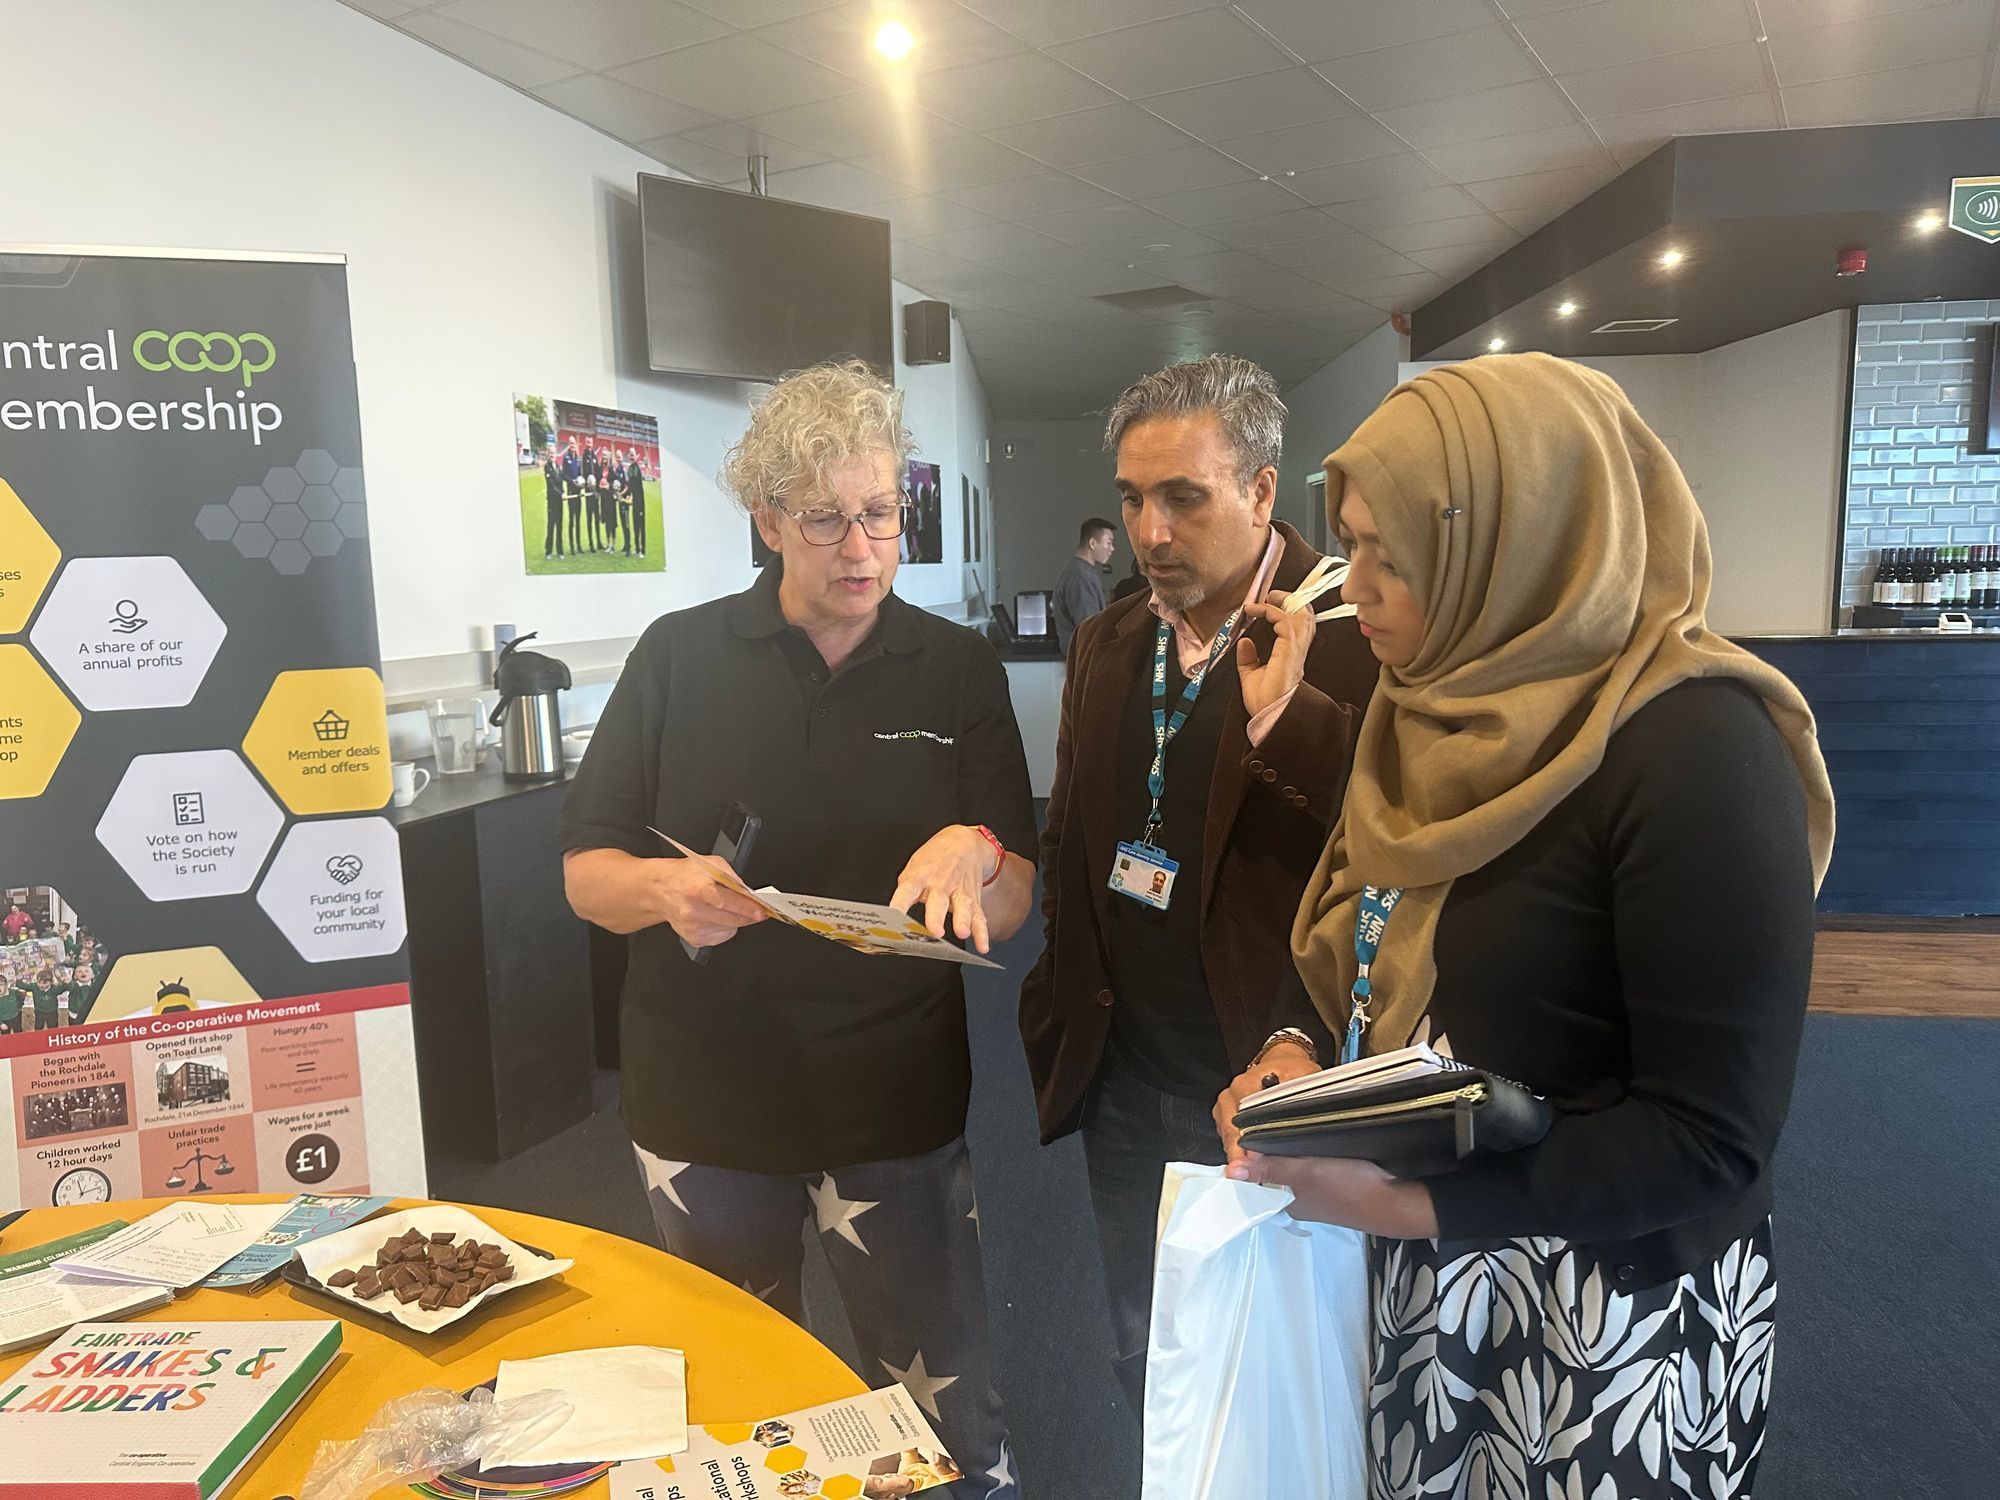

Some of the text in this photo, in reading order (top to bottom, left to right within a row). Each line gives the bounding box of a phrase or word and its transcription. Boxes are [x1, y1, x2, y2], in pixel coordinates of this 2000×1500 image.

[0, 329, 277, 388] ntral coop
[0, 385, 283, 446] embership
[1225, 609, 1241, 628] NHS
[78, 639, 183, 654] A share of our
[1157, 636, 1168, 656] NHS
[1212, 632, 1228, 656] NHS
[83, 655, 183, 670] annual profits
[1154, 662, 1165, 683] NHS
[0, 716, 23, 728] nts
[873, 732, 899, 740] central
[899, 730, 921, 739] coop
[0, 751, 19, 763] op
[288, 745, 380, 761] Member deals
[302, 761, 370, 775] and offers
[145, 830, 238, 846] Vote on how
[152, 845, 235, 862] the Society
[175, 863, 217, 875] is run
[310, 889, 384, 906] Funding for
[316, 903, 379, 922] your local
[313, 918, 386, 935] community
[1365, 914, 1385, 946] NHS
[48, 1001, 321, 1047] History of the Co-operative Movement
[273, 1024, 307, 1036] Hungry
[145, 1031, 233, 1051] Opened first shop
[43, 1051, 101, 1067] Began with
[158, 1044, 222, 1060] on Toad Lane
[39, 1062, 106, 1078] the Rochdale
[31, 1070, 116, 1089] Pioneers in 1844
[144, 1103, 245, 1123] Rochdale, 21st December 1844
[267, 1114, 301, 1126] Wages
[302, 1110, 316, 1120] for
[324, 1105, 351, 1116] week
[168, 1123, 226, 1139] Unfair trade
[289, 1119, 332, 1132] were just
[36, 1139, 121, 1160] Children worked
[176, 1134, 220, 1150] practices
[47, 1152, 113, 1169] 12 hour days
[296, 1145, 327, 1173] £1
[5, 1258, 42, 1274] WARMING
[70, 1331, 201, 1348] FAIRTRADE
[31, 1347, 288, 1380] SNAKES &
[0, 1382, 217, 1413] LADDERS
[131, 1460, 157, 1468] England
[731, 1455, 761, 1500] rkshops
